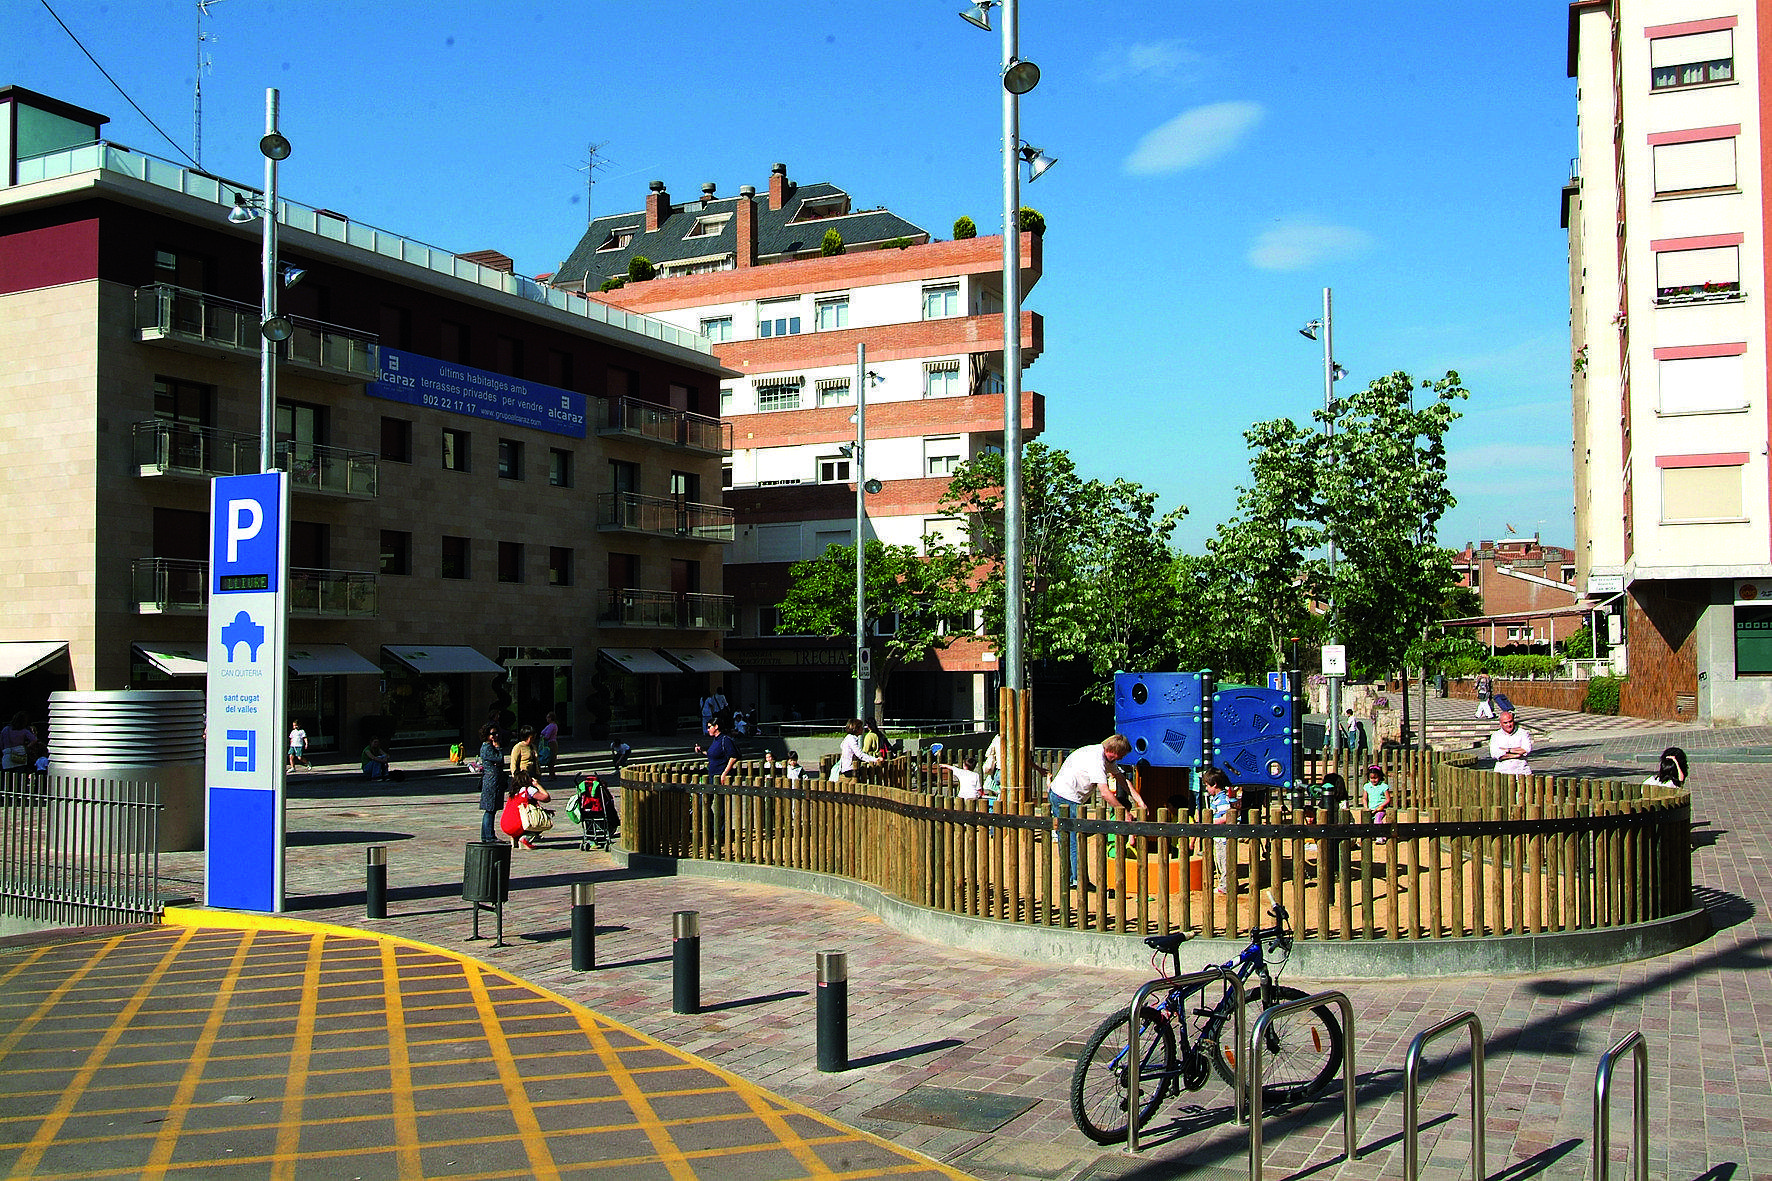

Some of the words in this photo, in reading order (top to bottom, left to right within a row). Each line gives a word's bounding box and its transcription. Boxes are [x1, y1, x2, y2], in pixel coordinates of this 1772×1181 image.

[439, 365, 465, 381] últims
[466, 372, 509, 391] habitatges
[510, 384, 528, 396] amb
[421, 377, 461, 395] terrasses
[462, 387, 498, 403] privades
[502, 396, 516, 406] per
[517, 400, 543, 413] vendre
[422, 393, 439, 407] 902
[440, 397, 452, 409] 22
[453, 400, 464, 411] 17
[466, 403, 477, 413] 17
[548, 407, 583, 424] alcaraz
[226, 498, 264, 563] P
[220, 669, 235, 677] CAN
[234, 669, 263, 677] QUITERIA
[223, 694, 239, 702] sant
[240, 694, 260, 704] cugat
[225, 704, 236, 713] del
